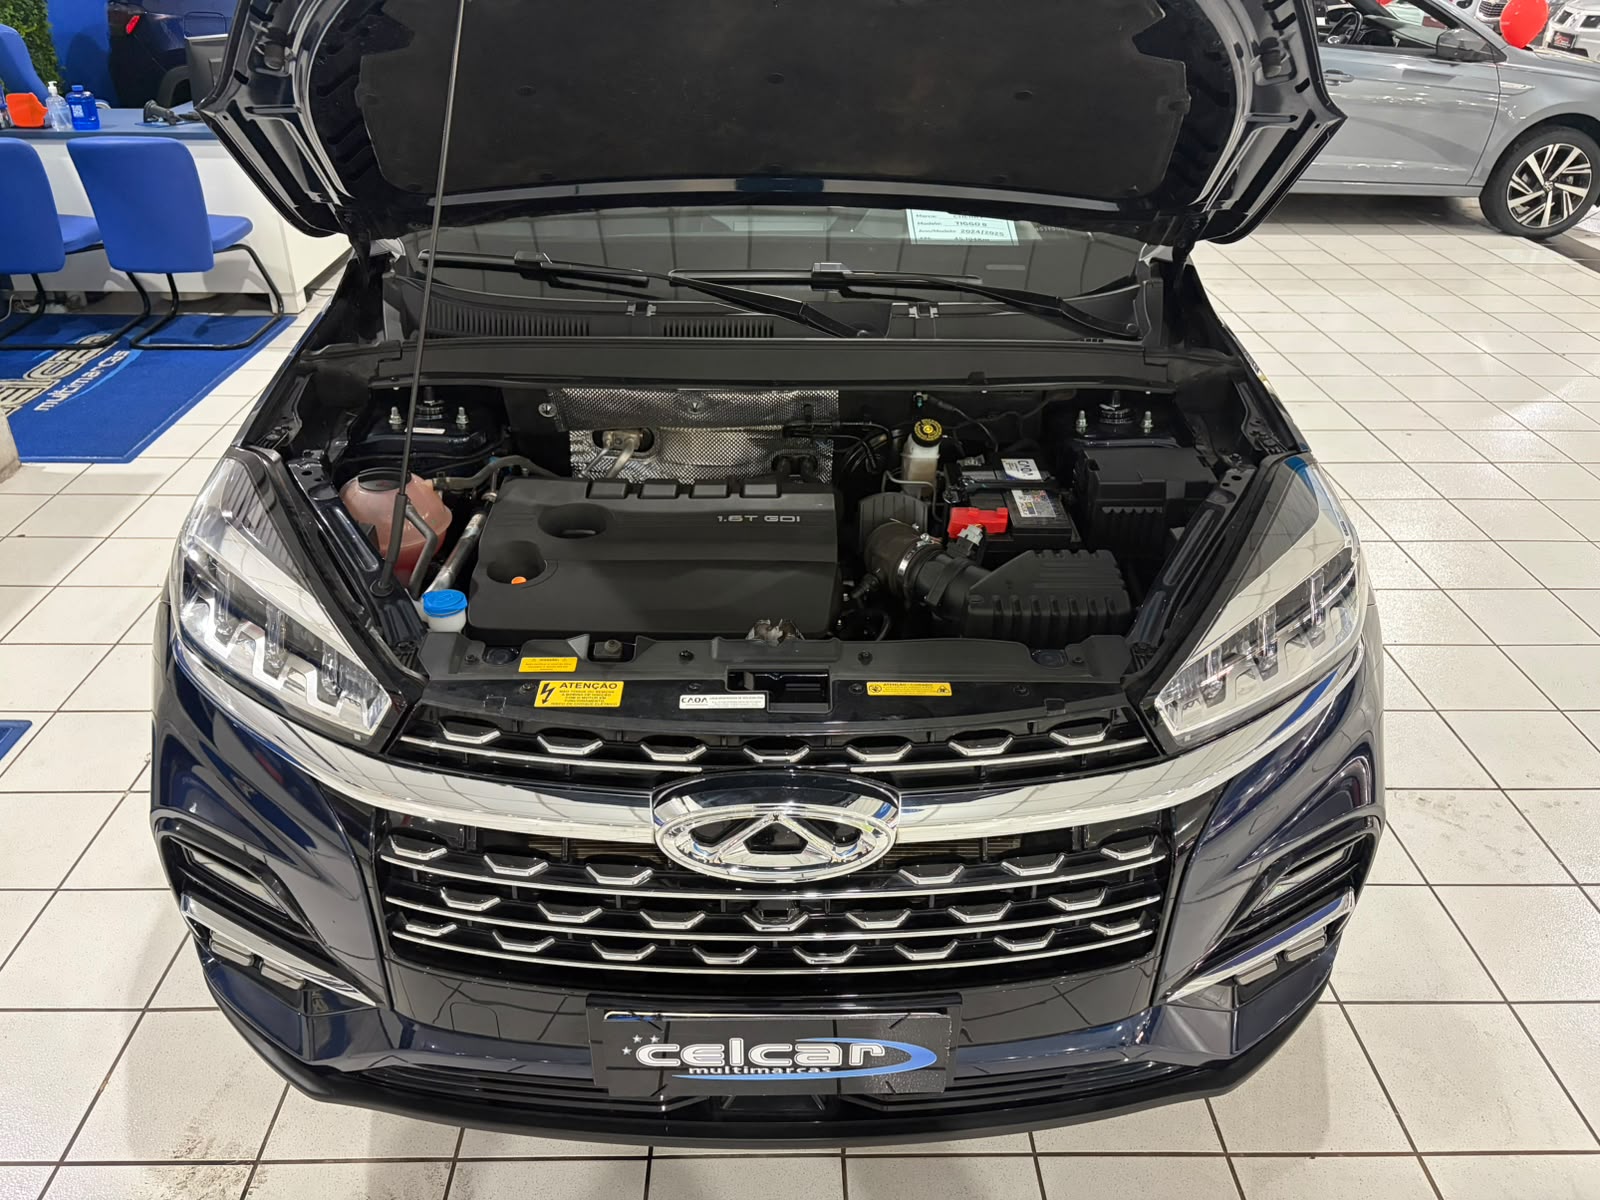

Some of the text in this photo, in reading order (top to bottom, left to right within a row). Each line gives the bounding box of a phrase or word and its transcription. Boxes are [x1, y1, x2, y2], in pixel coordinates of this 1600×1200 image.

[34, 350, 130, 411] multimarcas
[636, 1038, 885, 1066] celcar
[688, 1066, 832, 1075] multimarcas
